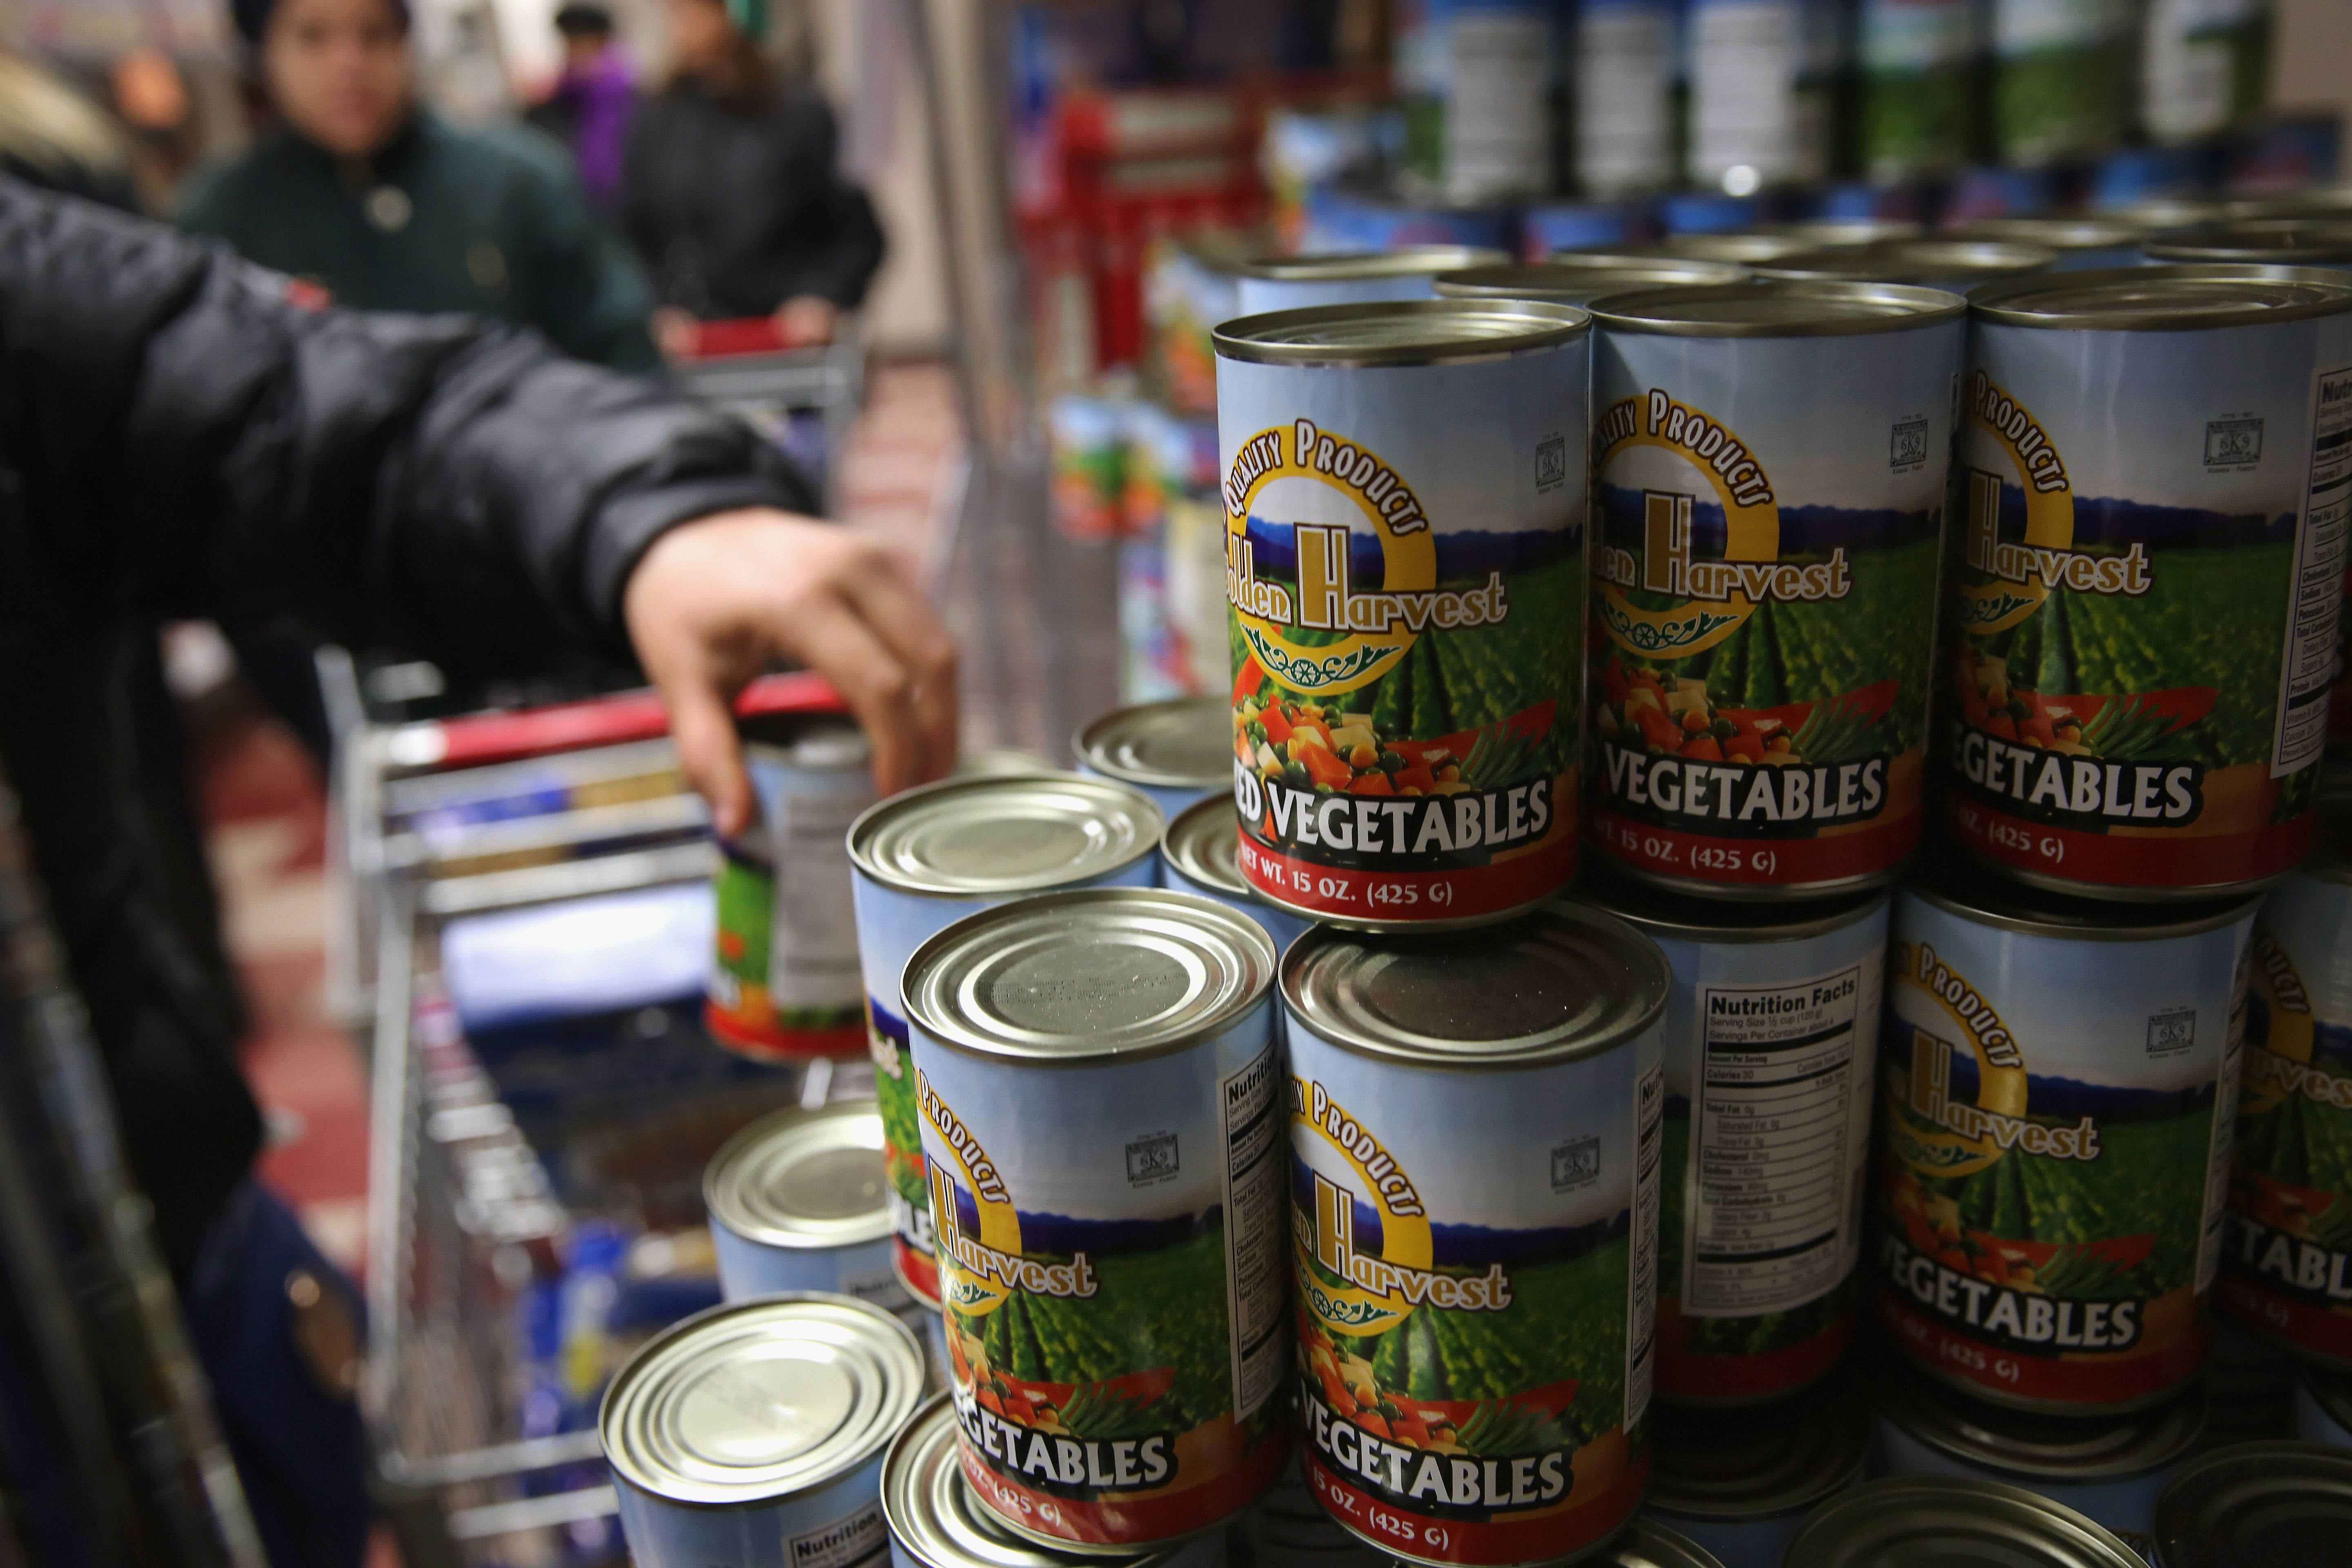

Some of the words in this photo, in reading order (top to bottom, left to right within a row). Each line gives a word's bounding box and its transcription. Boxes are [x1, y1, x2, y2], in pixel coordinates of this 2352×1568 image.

[1648, 389, 1774, 506] PRODUCTS
[1975, 369, 2068, 494] PRODUCTS
[1226, 431, 1283, 518] QUALITY
[1294, 418, 1428, 537] PRODUCTS
[1644, 491, 1854, 602] Harvest
[1967, 469, 2152, 596] Harvest
[1225, 532, 1293, 624] olden
[1295, 524, 1508, 633] Harvest
[2301, 588, 2321, 601] Sodium
[2297, 627, 2310, 639] Total
[2298, 605, 2325, 621] Potassium
[2290, 680, 2310, 695] Protein
[1605, 741, 1882, 821] VEGETABLES
[1267, 780, 1548, 854] VEGETABLES
[1621, 828, 1638, 851] 15
[1644, 837, 1679, 863] OZ.
[1690, 845, 1741, 871] (425
[1752, 850, 1776, 875] G)
[1987, 819, 2031, 852] (425
[2040, 836, 2064, 863] G)
[1261, 857, 1286, 885] WT.
[1292, 871, 1312, 893] 15
[1319, 877, 1356, 902] OZ.
[1367, 882, 1419, 908] (425
[1429, 882, 1452, 906] G)
[1711, 994, 1806, 1016] Nutrition
[1812, 980, 1855, 1007] Facts
[1920, 942, 2024, 1069] PRODUCTS
[1710, 1016, 1744, 1028] Serving
[1746, 1016, 1765, 1026] Size
[1780, 1014, 1795, 1025] cup
[1710, 1030, 1748, 1042] Servings
[1751, 1030, 1765, 1040] Per
[1768, 1025, 1806, 1040] Container
[1707, 1069, 1740, 1080] Calories
[1912, 1028, 2100, 1159] Harvest
[1229, 1098, 1250, 1118] Serving
[1230, 1110, 1254, 1131] Servings
[919, 1067, 1011, 1204] PRODUCTS
[1231, 1139, 1246, 1156] Amount
[1312, 1080, 1424, 1218] PRODUCTS
[1232, 1152, 1253, 1172] Calories
[1234, 1194, 1247, 1207] Total
[928, 1152, 1098, 1298] Harvest
[1237, 1227, 1264, 1256] Cholesterol
[1314, 1170, 1512, 1310] Harvest
[1237, 1252, 1256, 1271] Sodium
[1238, 1262, 1263, 1288] Potassium
[1239, 1285, 1252, 1302] Total
[1300, 1377, 1564, 1507] VEGETABLES
[797, 1512, 878, 1558] Nutrition
[1039, 1503, 1062, 1528] G)
[1330, 1485, 1361, 1517] OZ.
[1369, 1506, 1416, 1540] (425
[1424, 1527, 1449, 1552] G)
